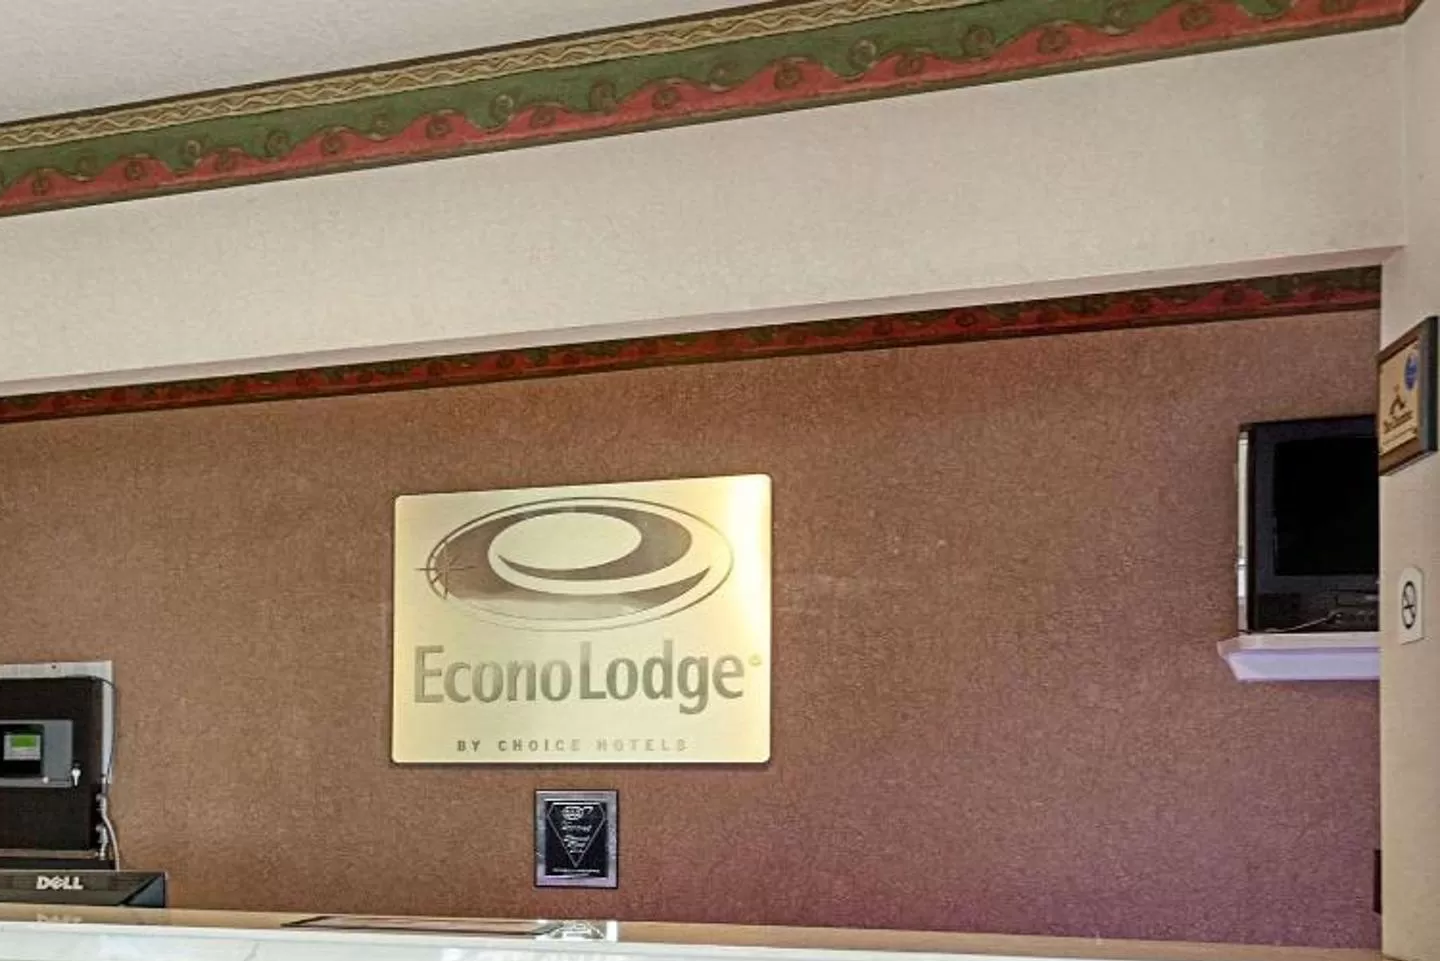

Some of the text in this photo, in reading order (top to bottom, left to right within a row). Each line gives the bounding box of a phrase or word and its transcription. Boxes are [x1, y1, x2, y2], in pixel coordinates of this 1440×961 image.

[413, 638, 745, 715] EconoLodge
[456, 738, 689, 752] BY CHOICE HOTELS
[36, 874, 84, 890] DELL
